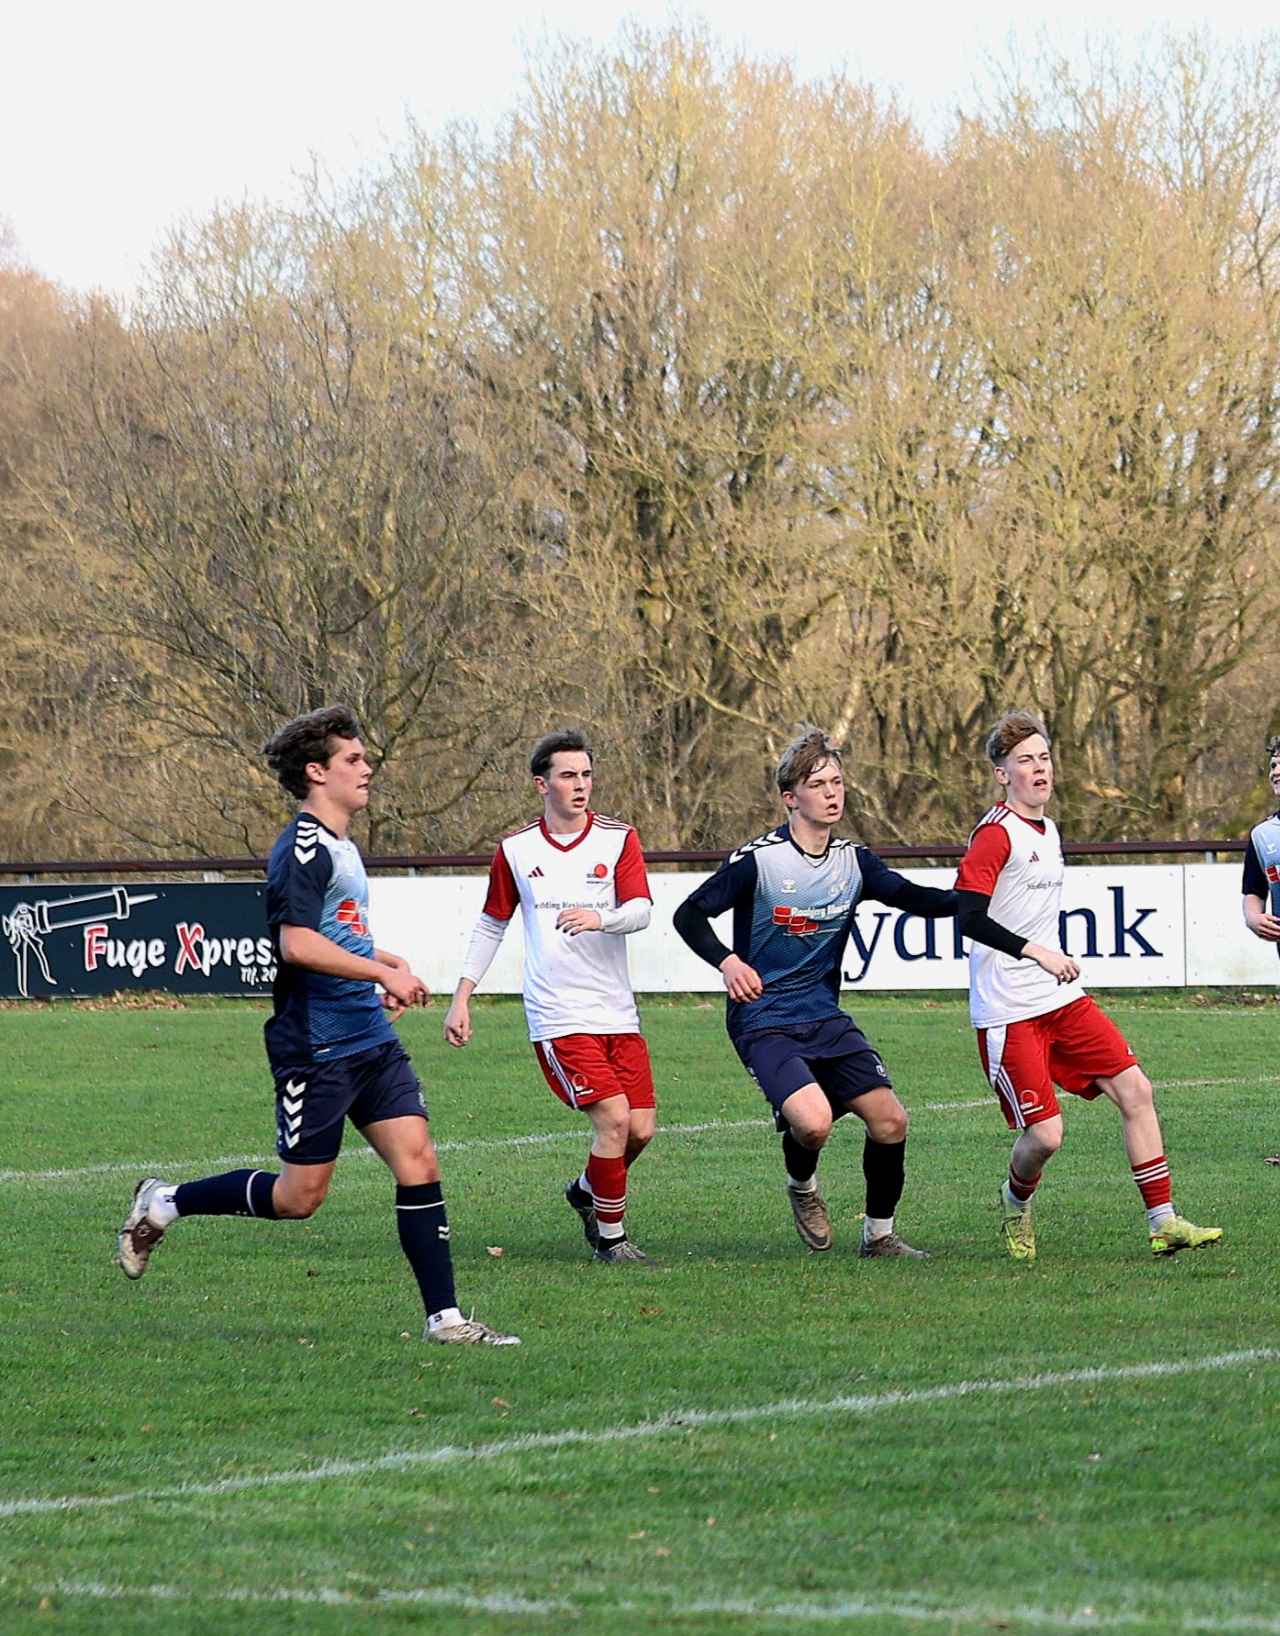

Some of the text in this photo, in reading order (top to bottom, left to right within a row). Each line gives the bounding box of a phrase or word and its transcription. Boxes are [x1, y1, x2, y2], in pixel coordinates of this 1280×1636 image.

[84, 922, 278, 977] Fuge Xpres
[844, 886, 1163, 983] ydnk
